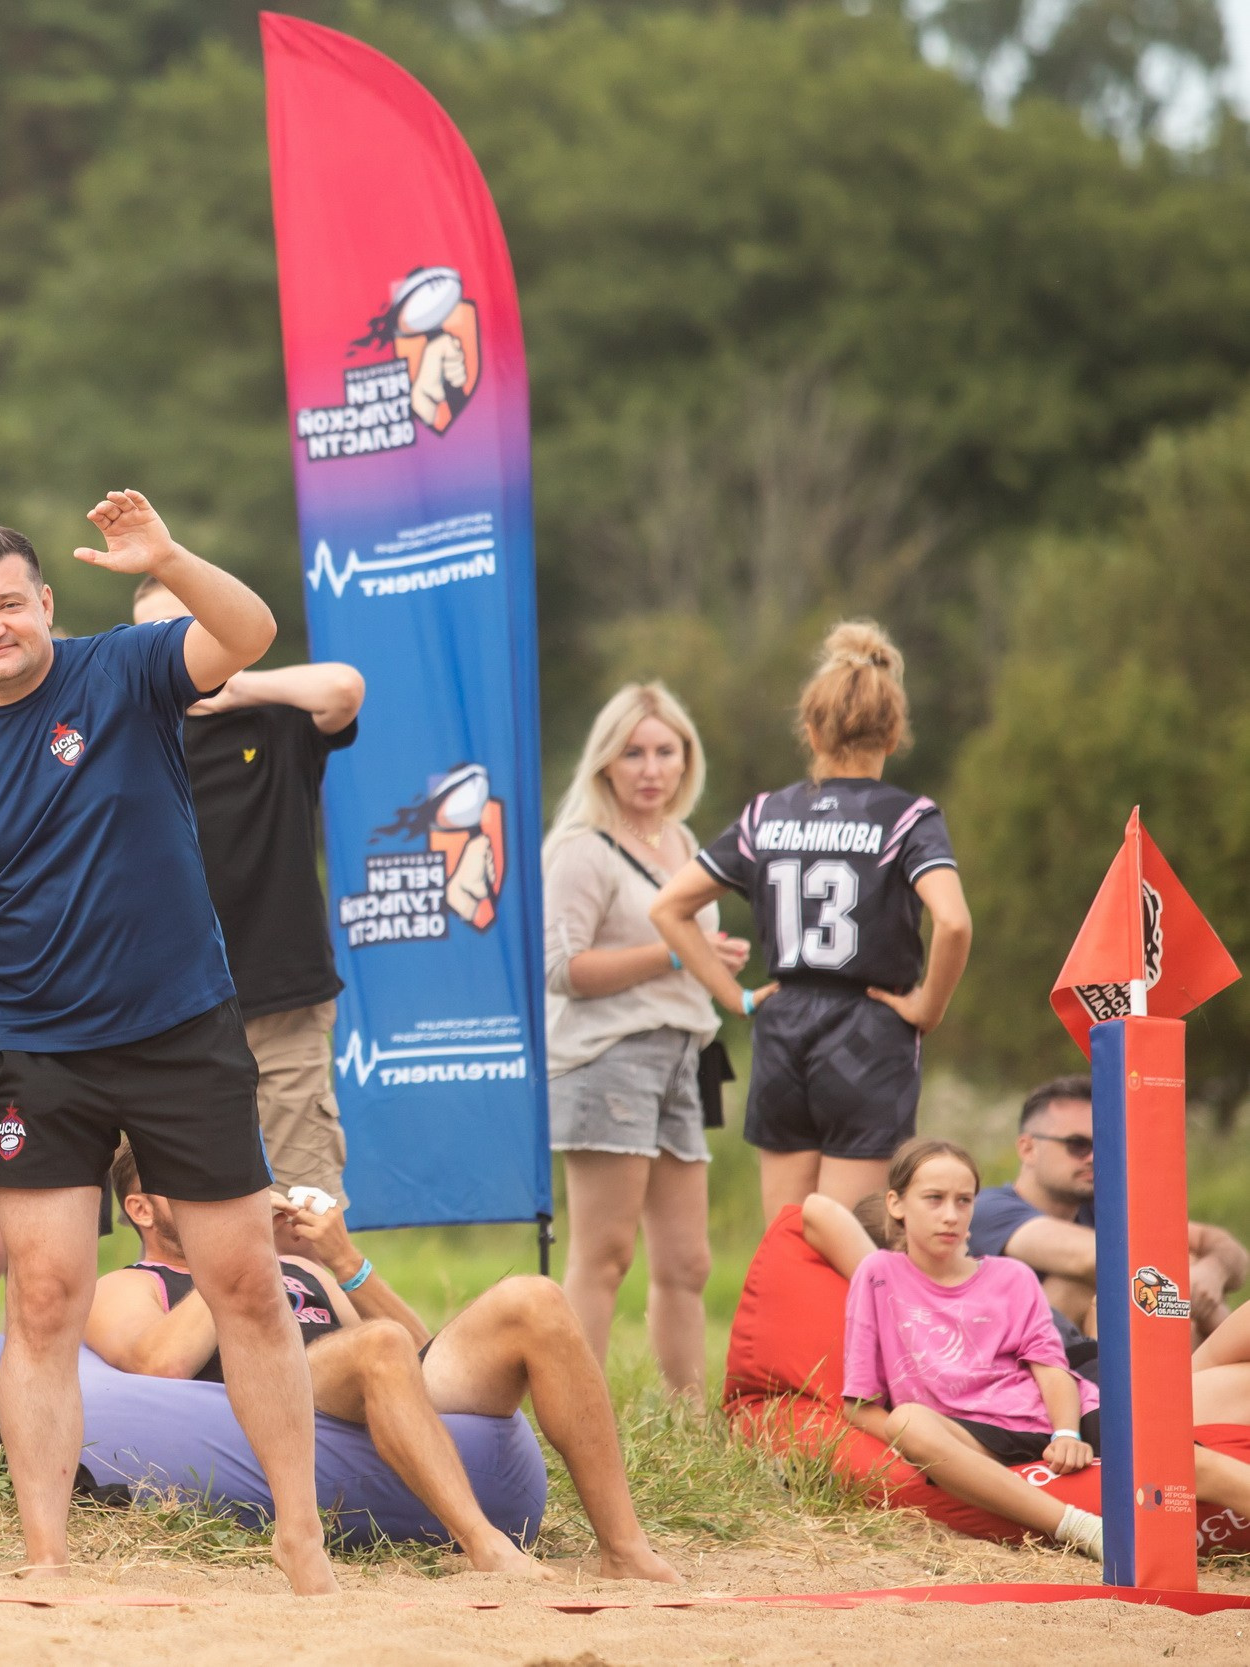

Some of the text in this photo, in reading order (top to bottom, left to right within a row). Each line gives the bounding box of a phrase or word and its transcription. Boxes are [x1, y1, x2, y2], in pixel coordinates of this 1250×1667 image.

[50, 731, 83, 756] ЦСКА
[755, 819, 883, 854] МЕЛЬНИКОВА
[767, 857, 859, 970] 13
